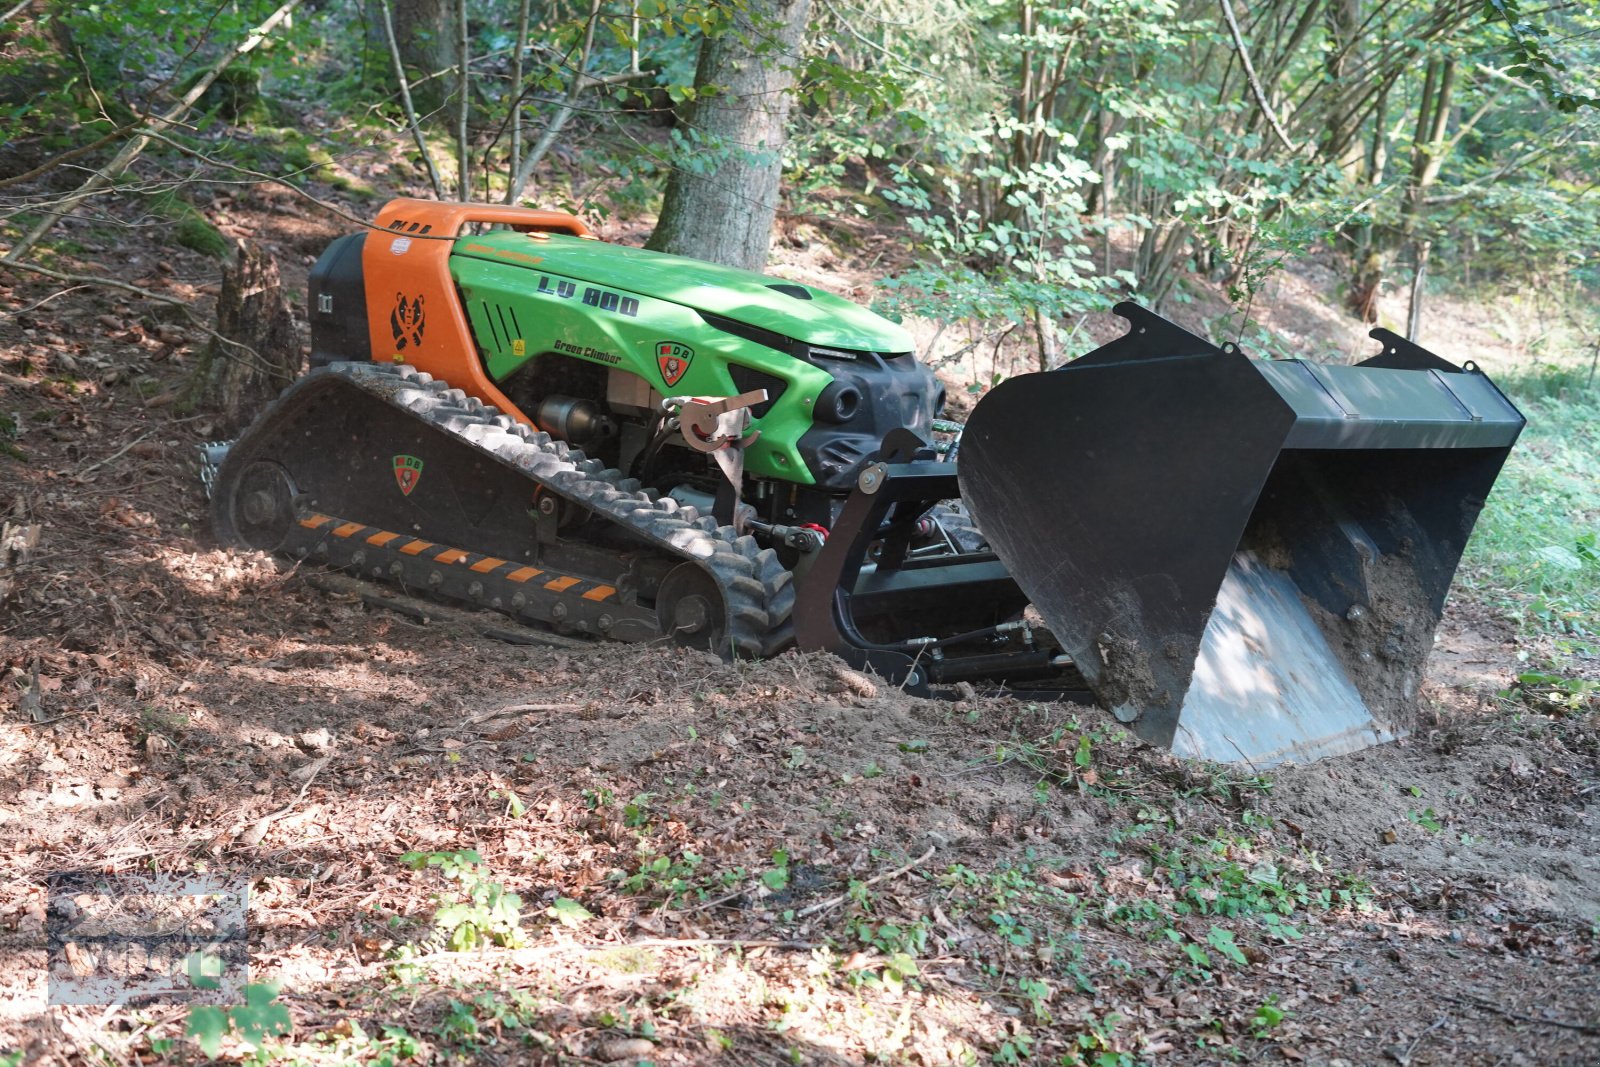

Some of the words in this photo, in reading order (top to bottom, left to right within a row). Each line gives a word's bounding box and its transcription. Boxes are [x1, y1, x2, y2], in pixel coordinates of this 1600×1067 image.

[582, 287, 640, 317] 800
[554, 339, 583, 355] Green
[583, 347, 622, 364] Climber
[660, 344, 690, 359] MDB
